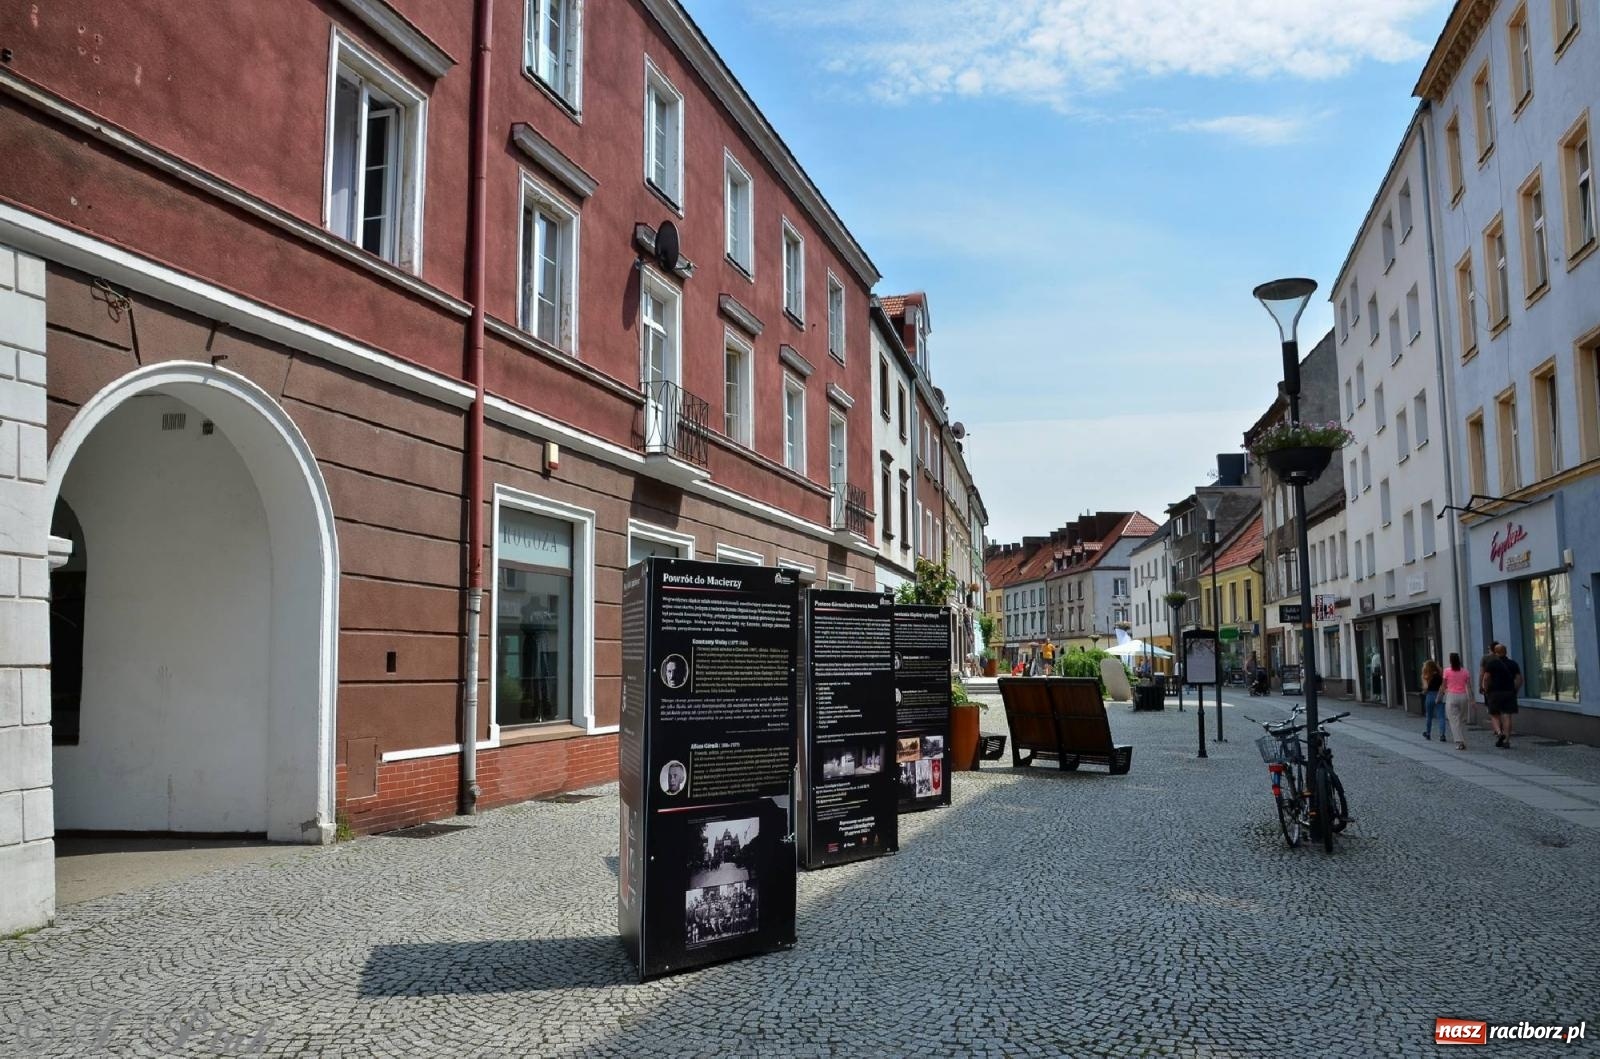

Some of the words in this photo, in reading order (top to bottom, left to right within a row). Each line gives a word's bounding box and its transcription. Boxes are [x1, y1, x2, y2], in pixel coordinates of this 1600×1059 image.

[663, 572, 693, 584] Powrót
[694, 575, 705, 585] do
[707, 576, 742, 589] Macierzy
